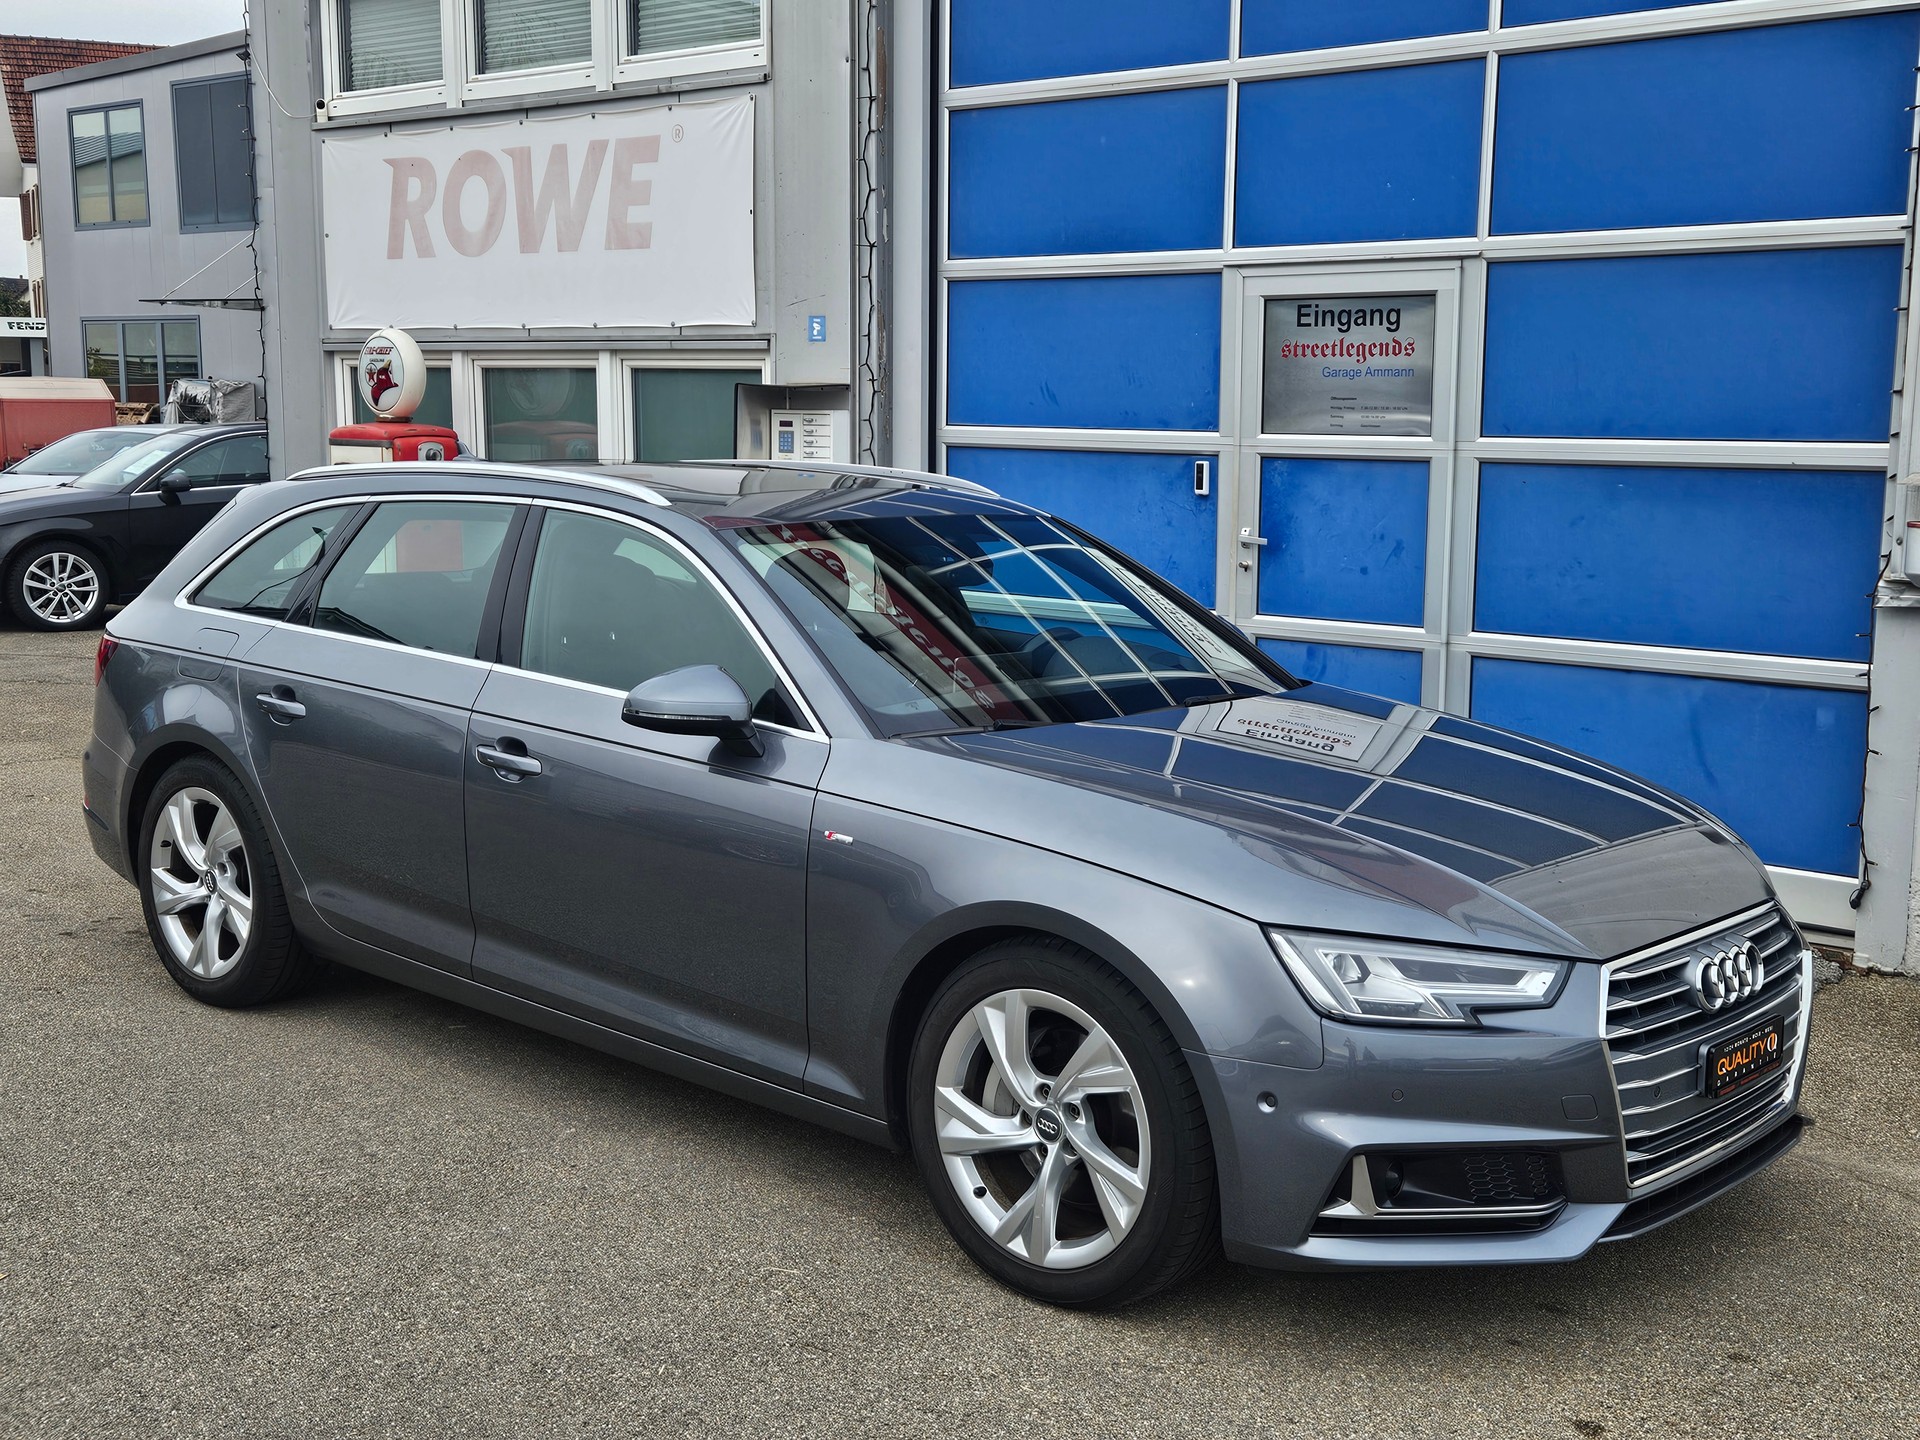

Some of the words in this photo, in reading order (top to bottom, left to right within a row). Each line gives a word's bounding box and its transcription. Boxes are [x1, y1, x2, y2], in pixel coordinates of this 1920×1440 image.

[382, 134, 661, 260] ROWE
[1296, 303, 1401, 333] Eingang
[1281, 336, 1416, 365] streetlegends
[1322, 366, 1362, 380] Garage
[1364, 366, 1415, 378] Ammann
